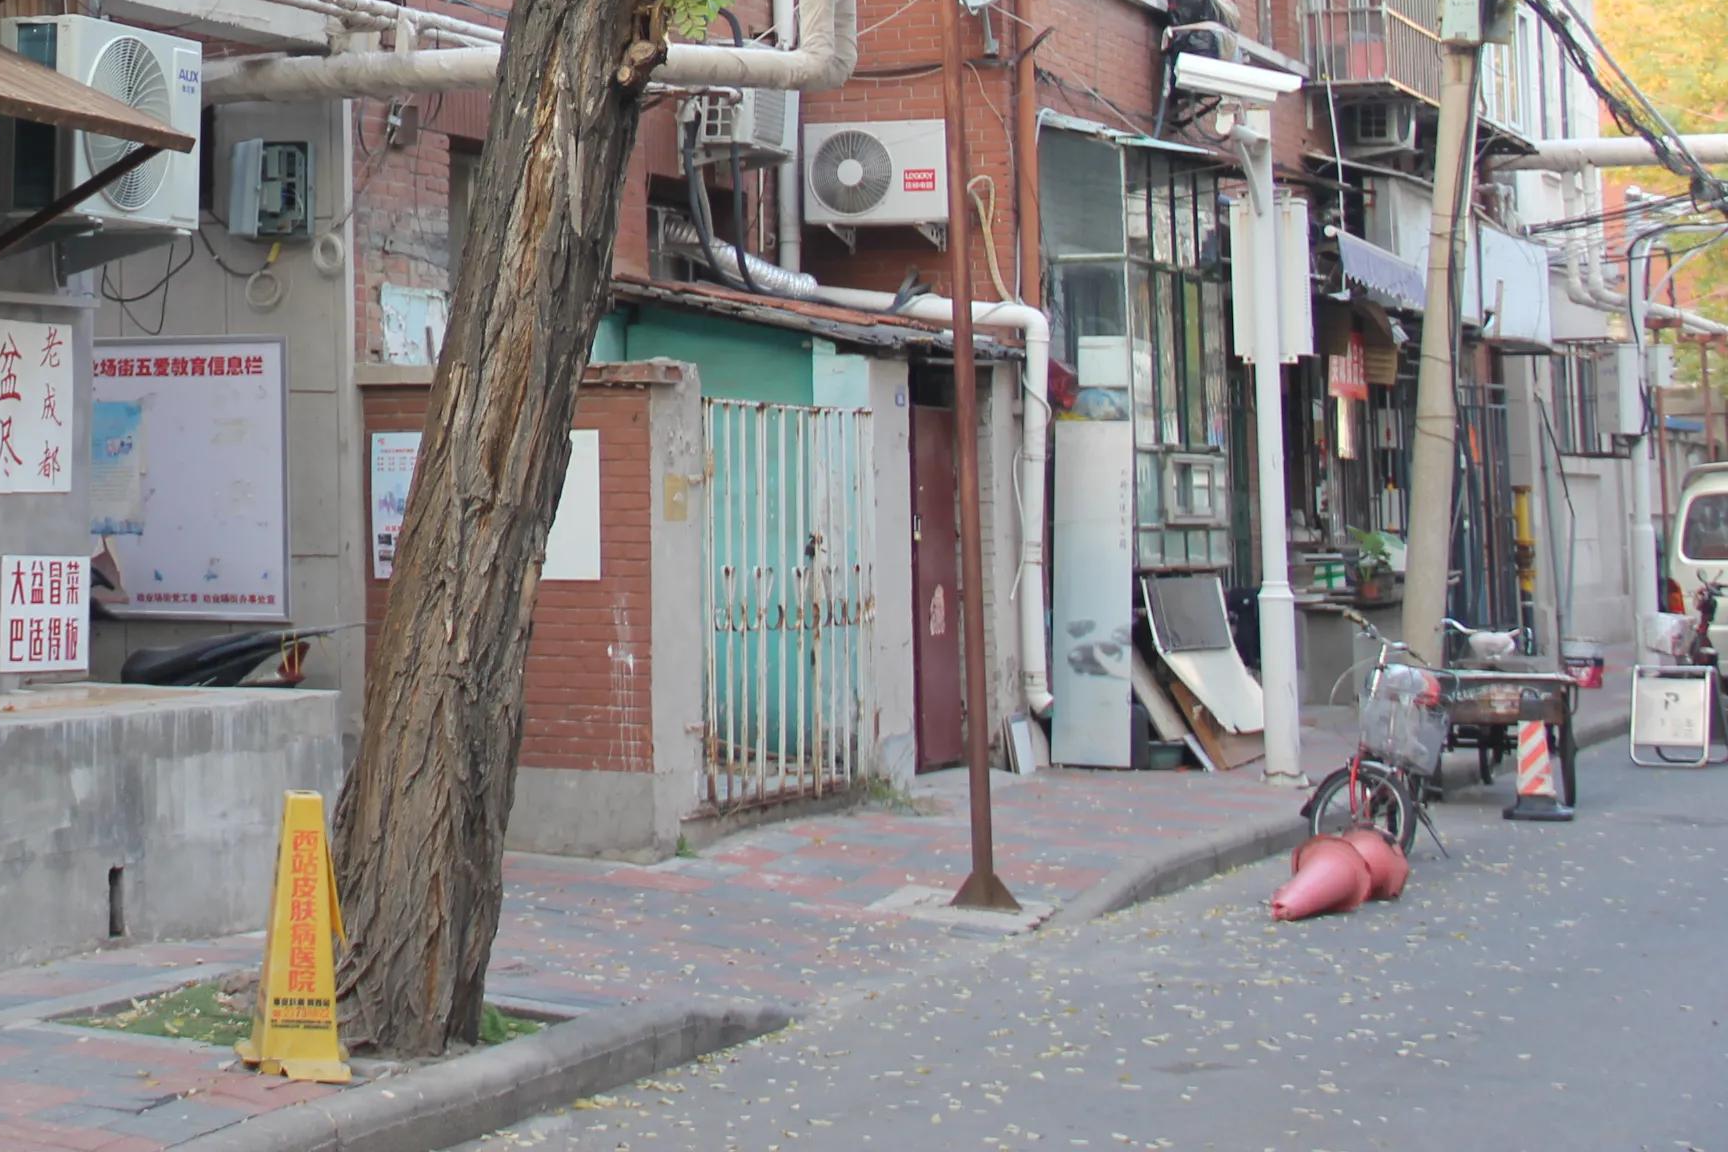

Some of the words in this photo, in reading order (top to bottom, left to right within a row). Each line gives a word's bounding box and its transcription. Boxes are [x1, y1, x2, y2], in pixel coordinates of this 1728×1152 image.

[179, 68, 199, 83] AUX
[37, 326, 64, 486] 老成都
[11, 560, 80, 604] 大盆冒菜
[288, 829, 319, 993] 西站皮肤病医院
